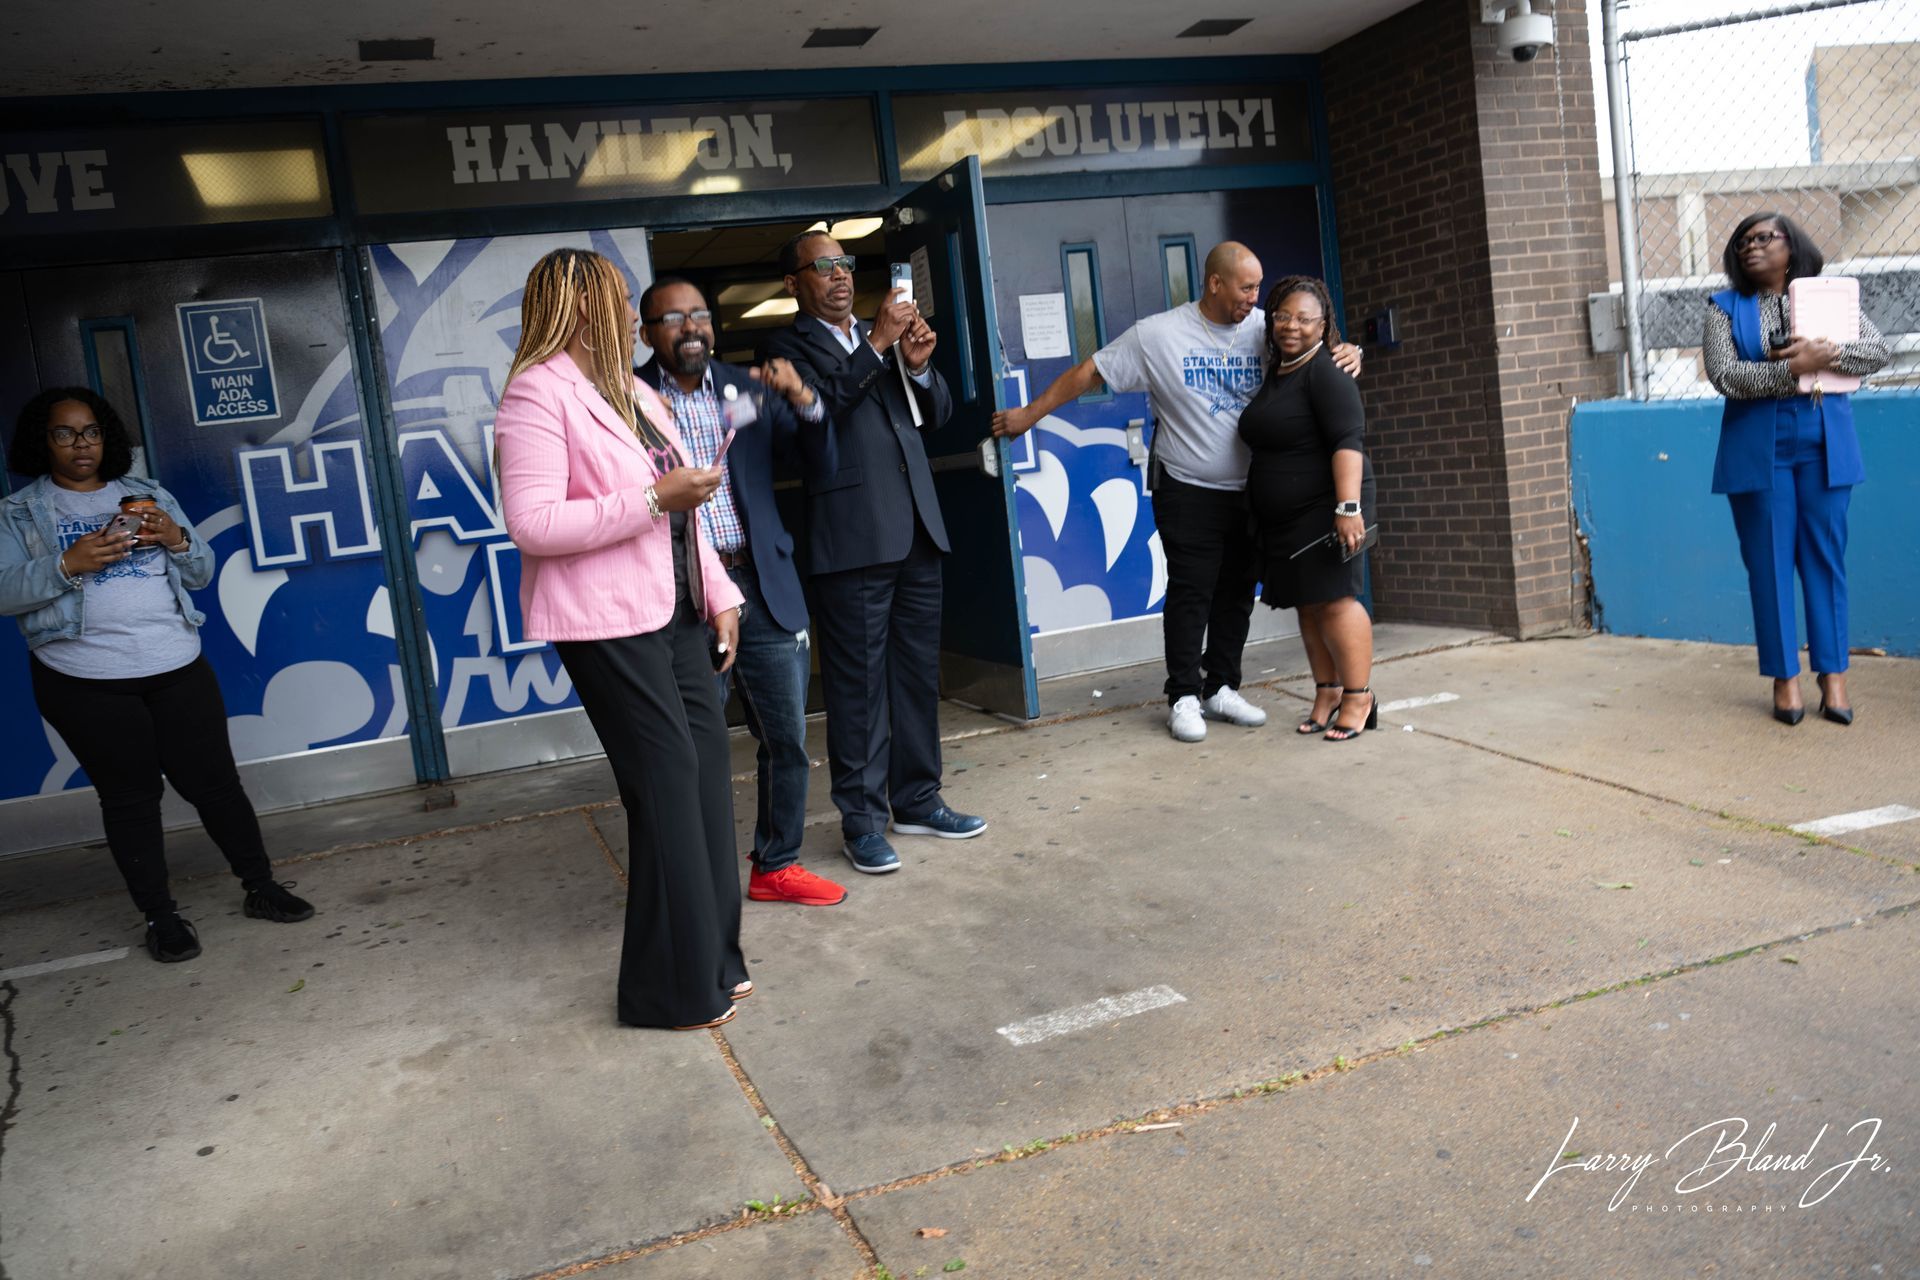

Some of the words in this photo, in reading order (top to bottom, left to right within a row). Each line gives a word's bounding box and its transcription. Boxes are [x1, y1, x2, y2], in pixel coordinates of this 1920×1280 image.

[0, 149, 115, 215] VE
[446, 113, 793, 185] HAMILTON,
[938, 98, 1276, 164] ABSOLUTELY!
[1246, 356, 1261, 367] ON
[211, 374, 254, 390] MAIN
[1183, 367, 1263, 393] BUSINESS
[218, 388, 252, 403] ADA
[206, 399, 269, 418] ACCESS
